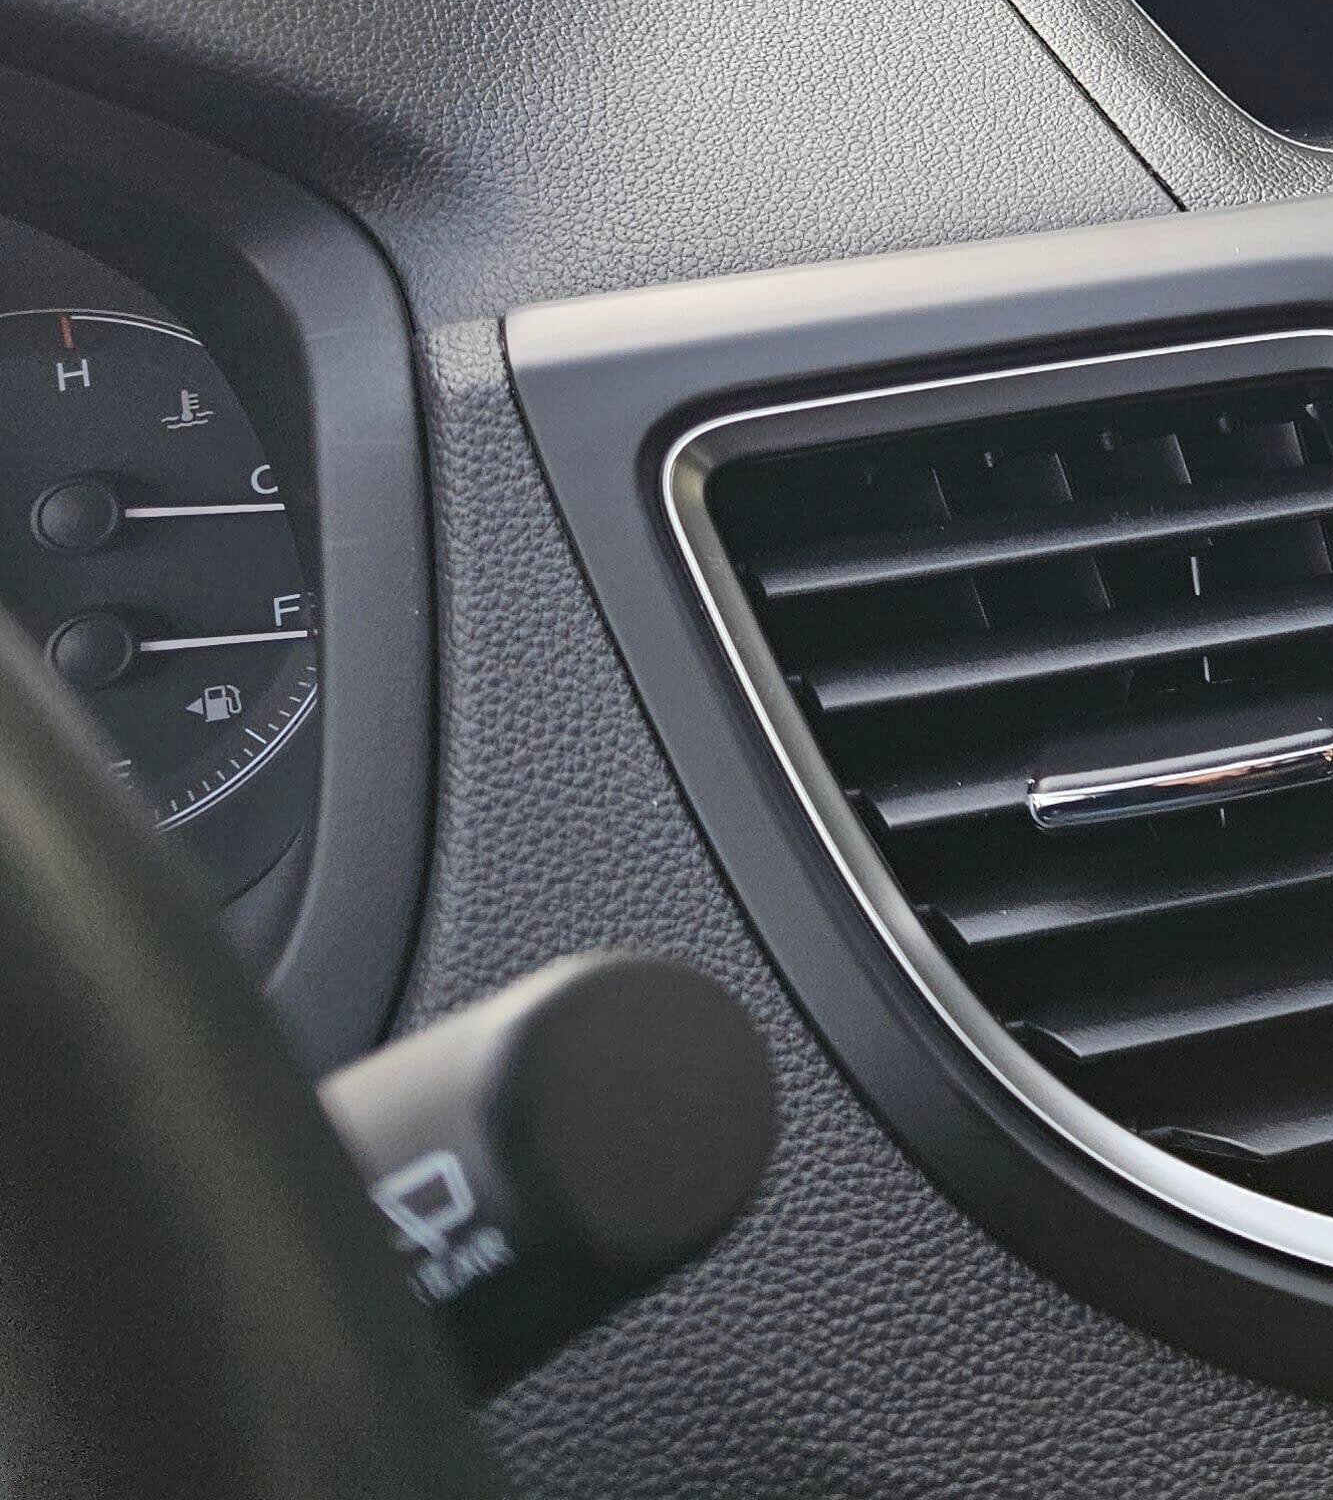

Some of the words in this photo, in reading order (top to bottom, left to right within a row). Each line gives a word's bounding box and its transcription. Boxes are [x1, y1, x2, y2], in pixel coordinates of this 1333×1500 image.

[56, 358, 90, 392] H
[249, 464, 279, 496] C
[273, 593, 301, 628] F
